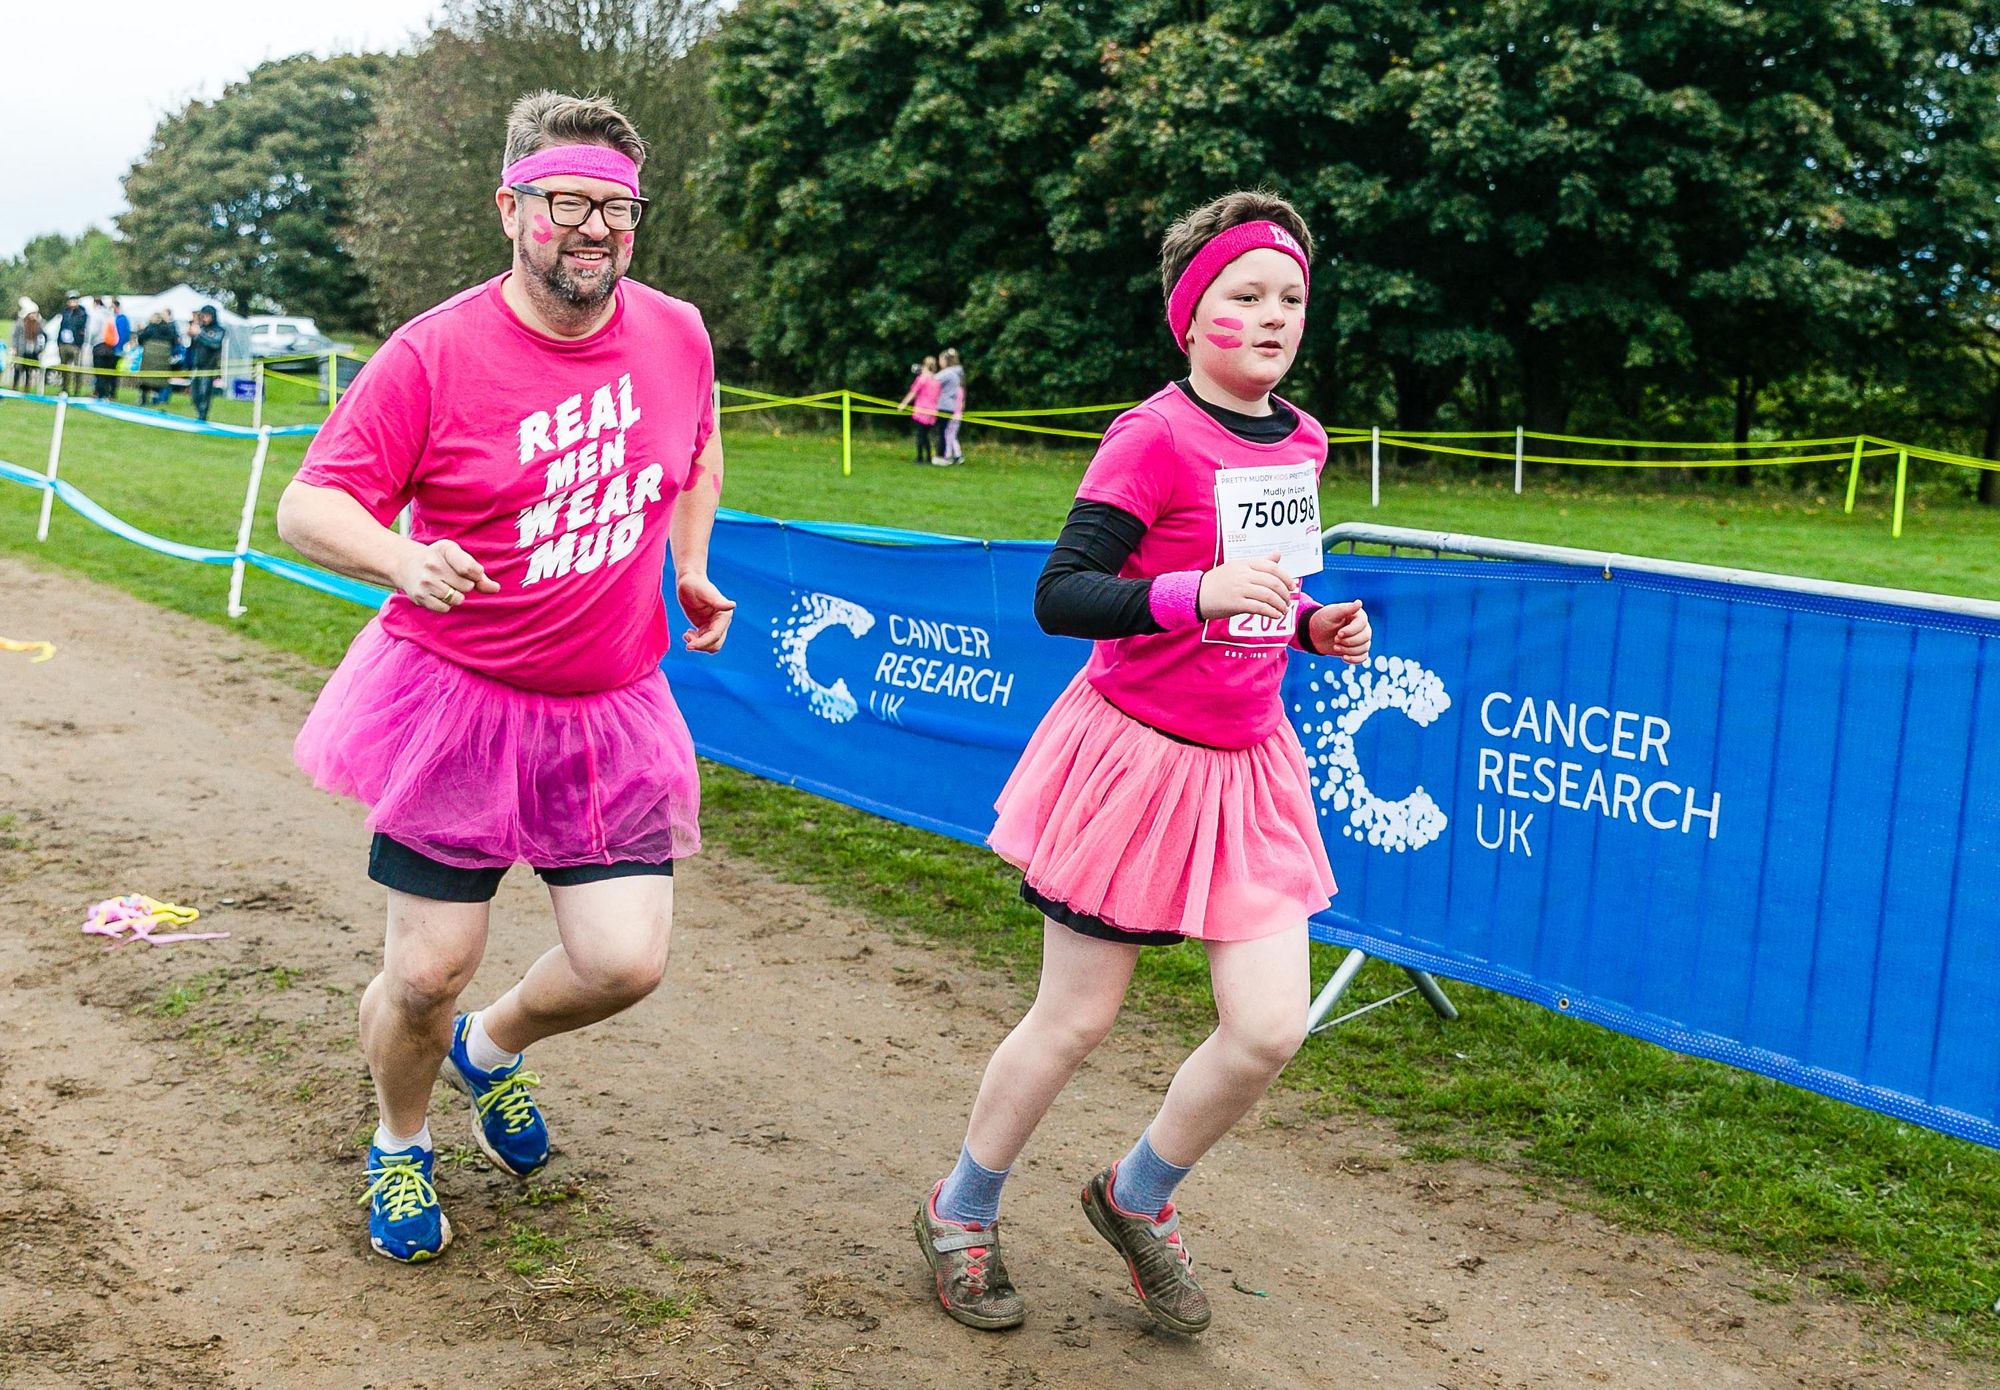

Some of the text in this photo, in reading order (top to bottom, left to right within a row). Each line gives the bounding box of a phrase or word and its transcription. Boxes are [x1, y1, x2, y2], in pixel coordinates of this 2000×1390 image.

[516, 372, 641, 465] REAL
[543, 432, 626, 498] MEN
[1263, 487, 1286, 497] Mudly
[515, 463, 664, 549] WEAR
[1238, 495, 1315, 529] 750098
[521, 511, 647, 588] MUD
[889, 614, 991, 659] CANCER
[869, 690, 905, 726] UK
[875, 652, 1015, 707] RESEARCH
[1480, 692, 1671, 766] CANCER
[1477, 748, 1721, 839] RESEARCH
[1476, 803, 1534, 858] UK
